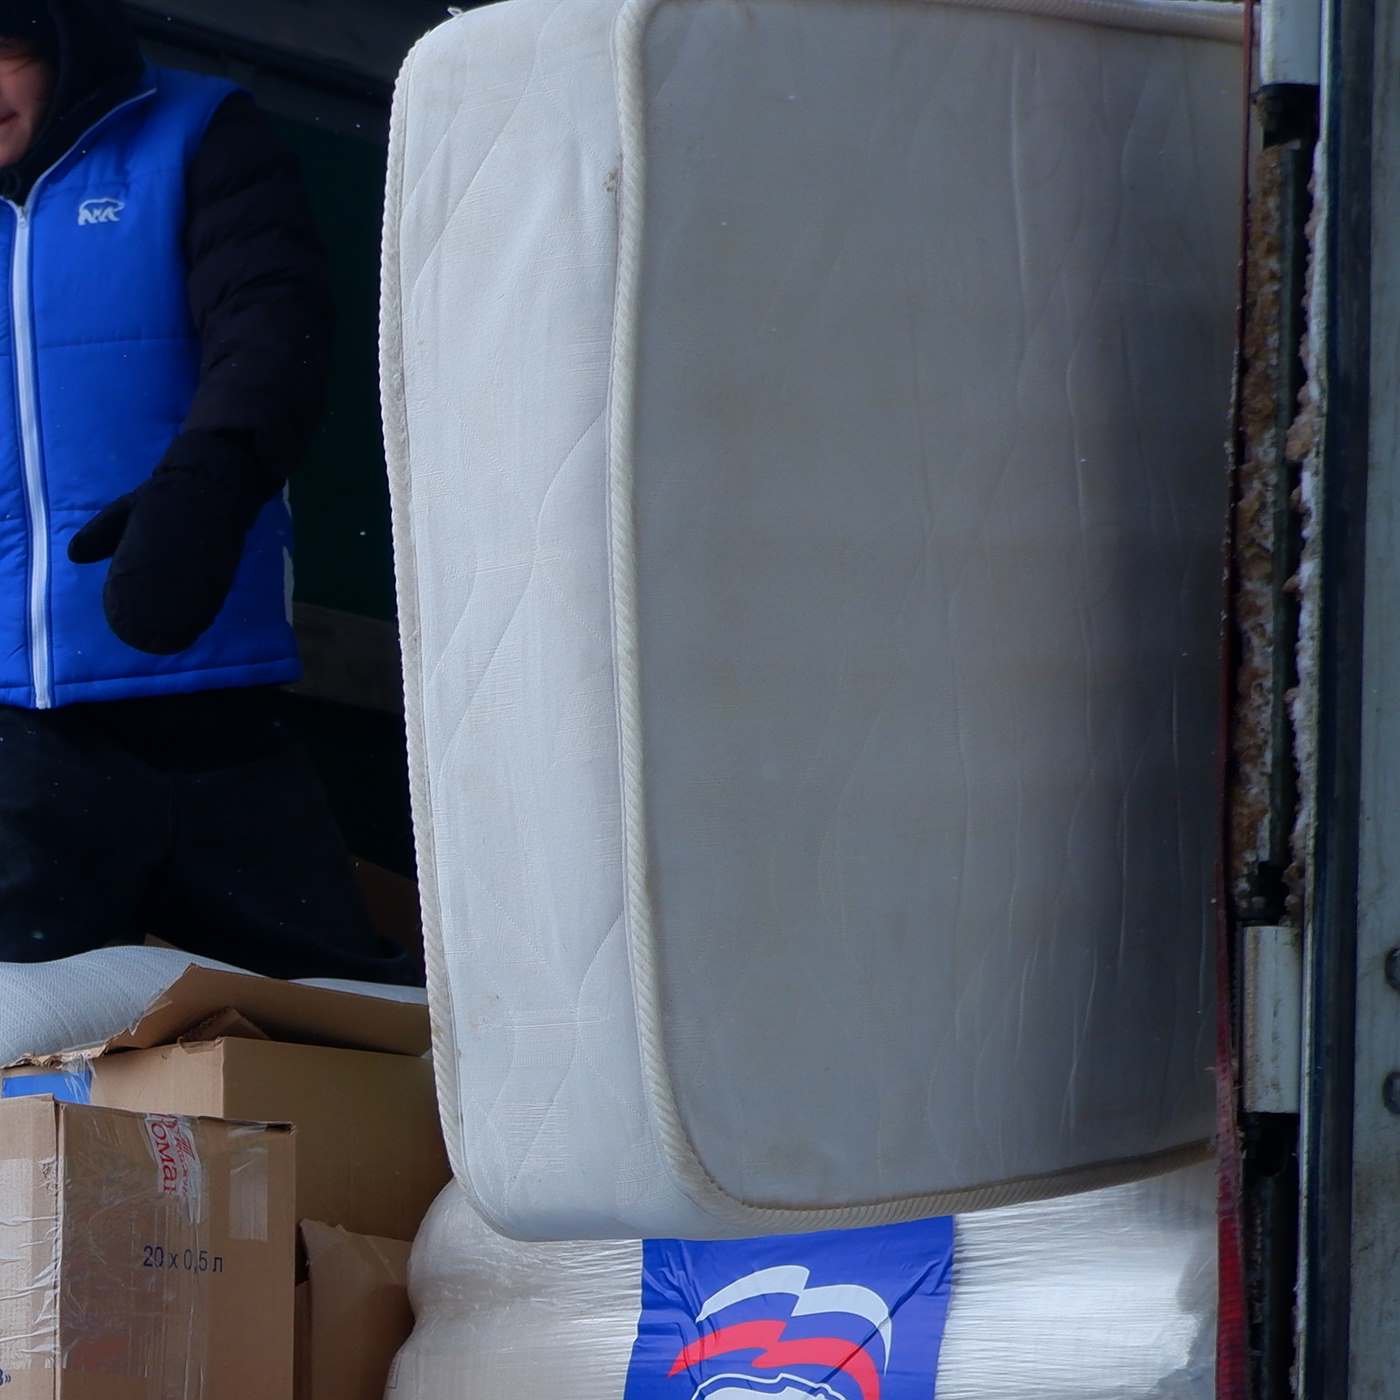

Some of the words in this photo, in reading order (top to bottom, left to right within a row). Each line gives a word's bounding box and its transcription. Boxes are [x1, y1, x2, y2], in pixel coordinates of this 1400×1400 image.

[143, 1246, 164, 1267] 20
[183, 1249, 208, 1273] 0,5
[212, 1257, 223, 1273] л
